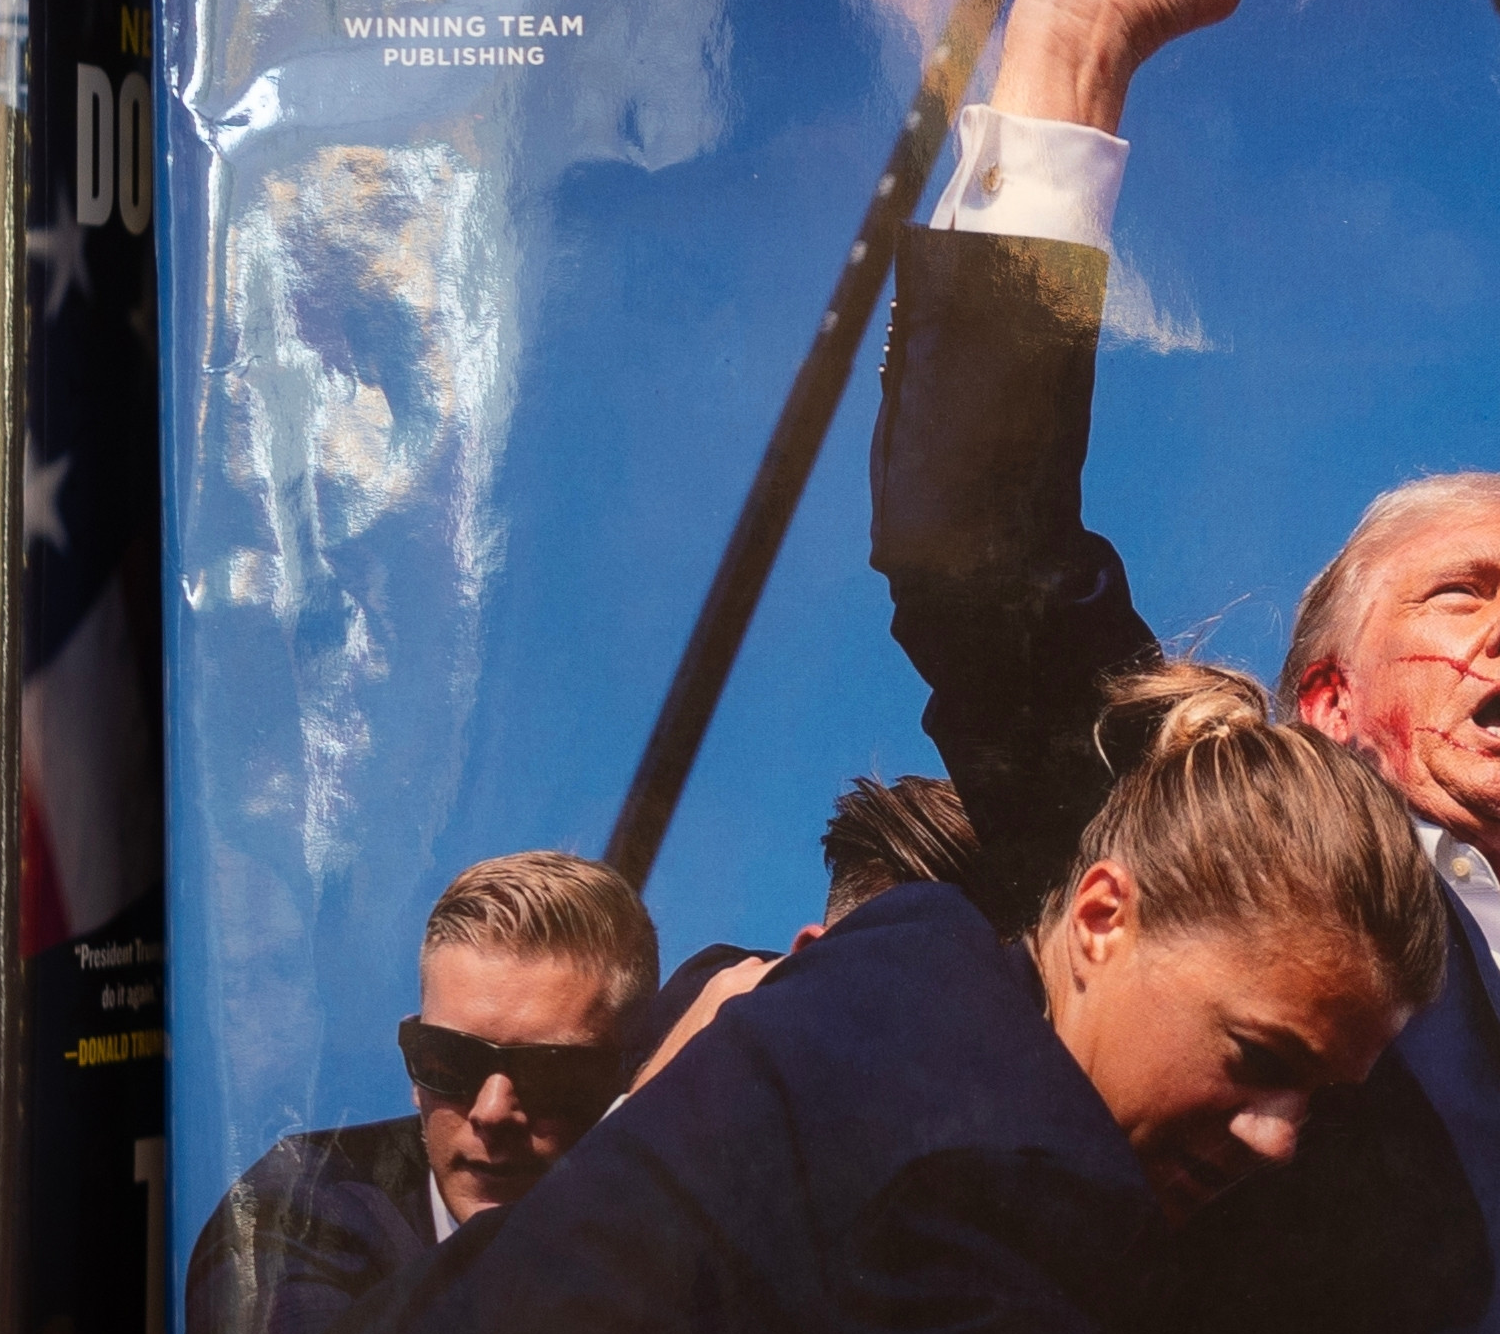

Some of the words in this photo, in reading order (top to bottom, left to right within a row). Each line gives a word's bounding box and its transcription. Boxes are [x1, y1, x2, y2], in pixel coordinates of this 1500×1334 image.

[344, 15, 487, 39] WINNING
[499, 14, 584, 38] TEAM
[383, 46, 545, 67] PUBLISHING
